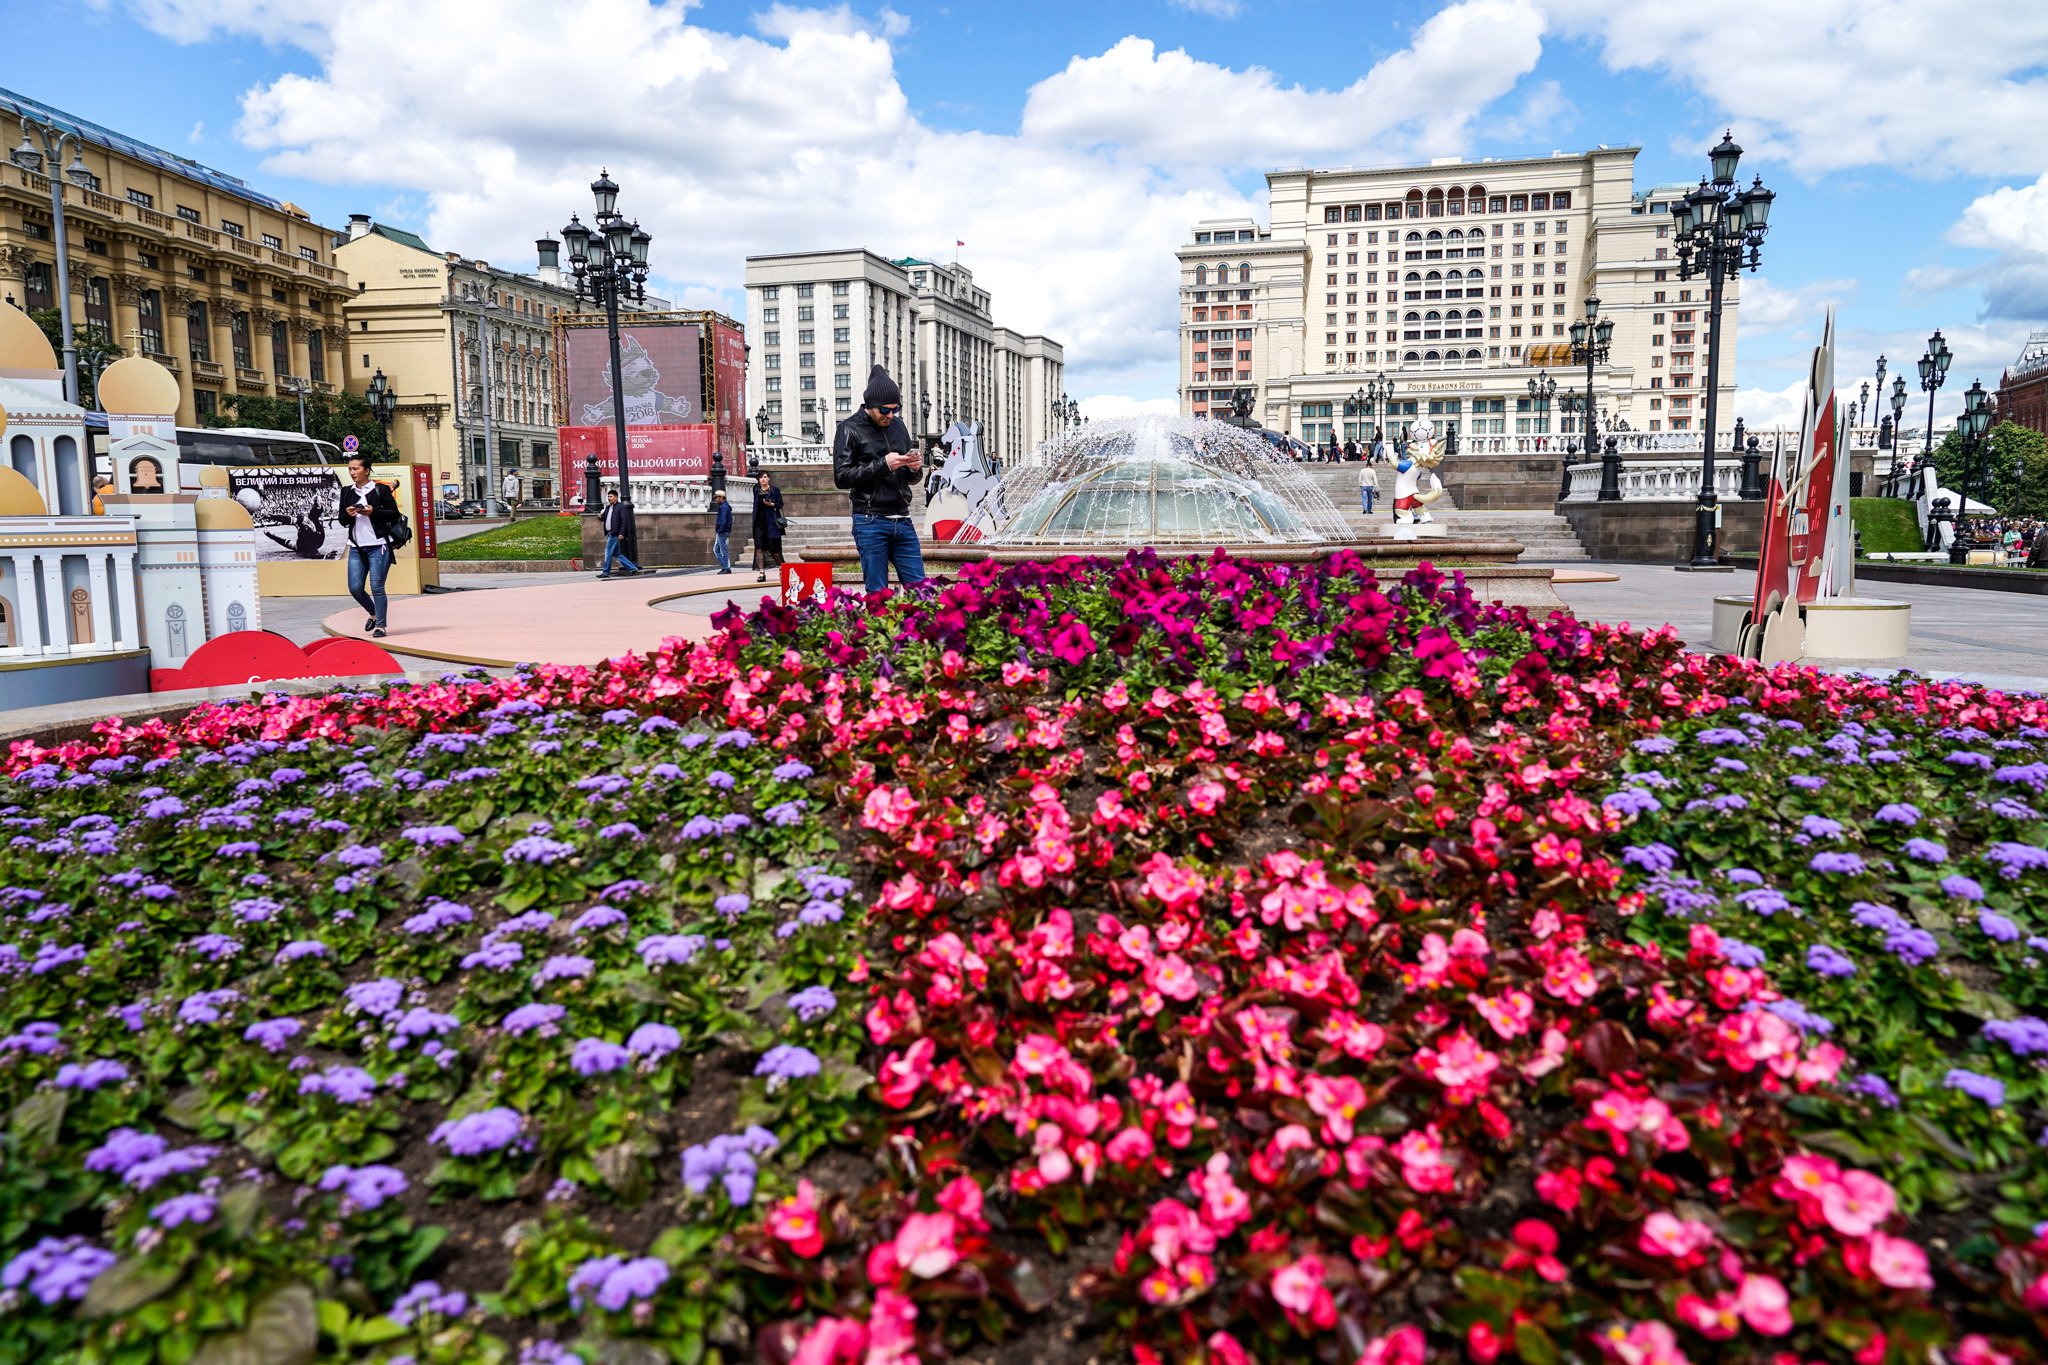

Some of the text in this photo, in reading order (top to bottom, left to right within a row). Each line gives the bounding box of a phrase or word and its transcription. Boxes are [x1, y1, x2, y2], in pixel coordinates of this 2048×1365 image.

[625, 402, 653, 413] RUSSIA
[628, 408, 655, 422] 2018
[665, 456, 702, 468] ИГРОЙ
[235, 475, 278, 486] ВЕЛИКИЙ
[279, 477, 295, 485] ЛЕВ
